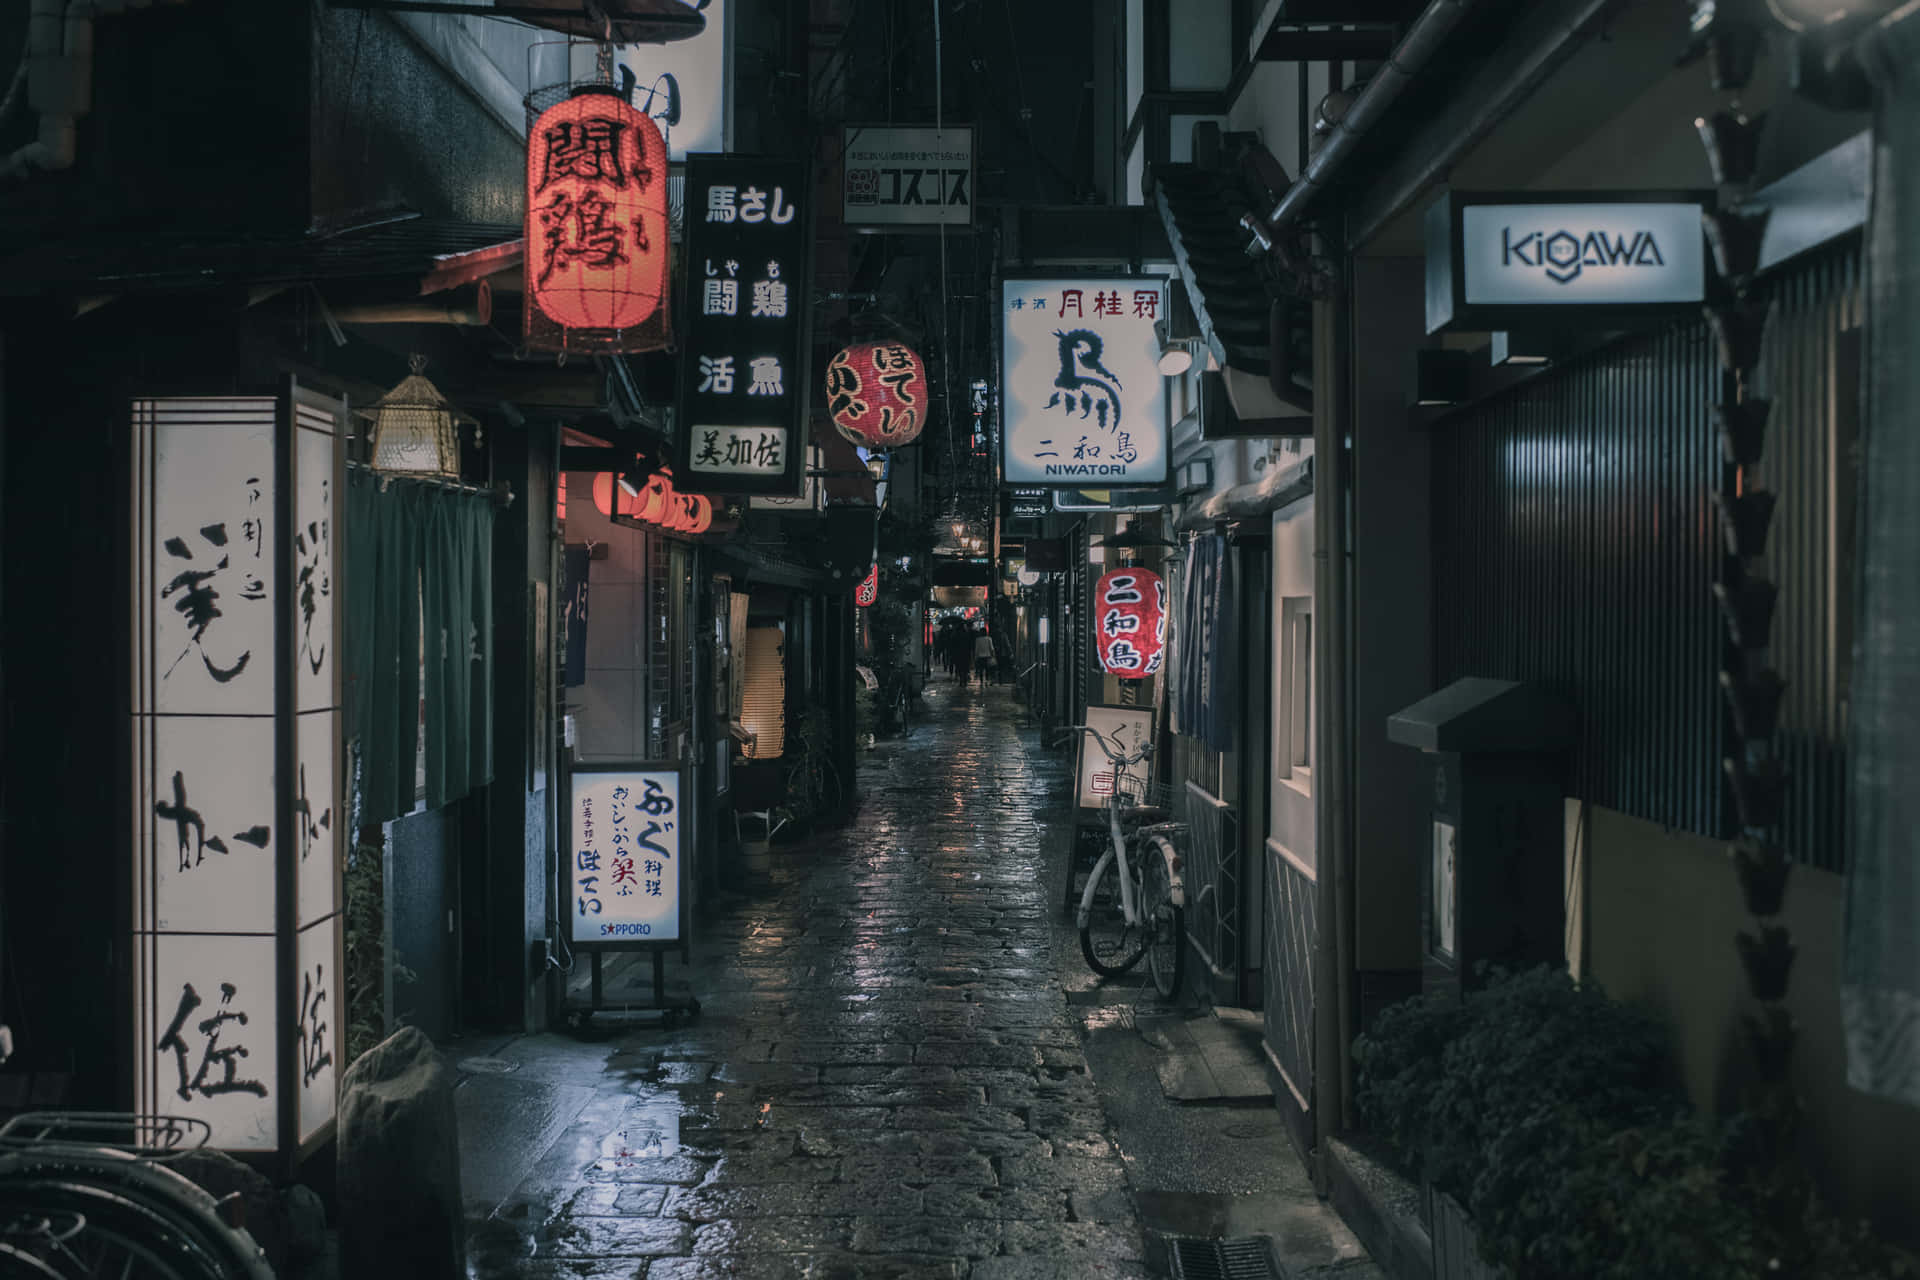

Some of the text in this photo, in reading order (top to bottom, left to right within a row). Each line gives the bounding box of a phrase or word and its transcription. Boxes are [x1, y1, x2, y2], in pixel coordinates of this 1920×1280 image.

[705, 186, 794, 224] 馬さし
[1058, 289, 1160, 320] 月桂冠
[698, 355, 785, 395] 活魚
[873, 346, 916, 435] ほてい
[694, 430, 781, 467] 美加佐
[1033, 431, 1138, 463] 二和鳥
[1045, 464, 1127, 475] NIWATORI
[1104, 576, 1141, 669] 二和鳥
